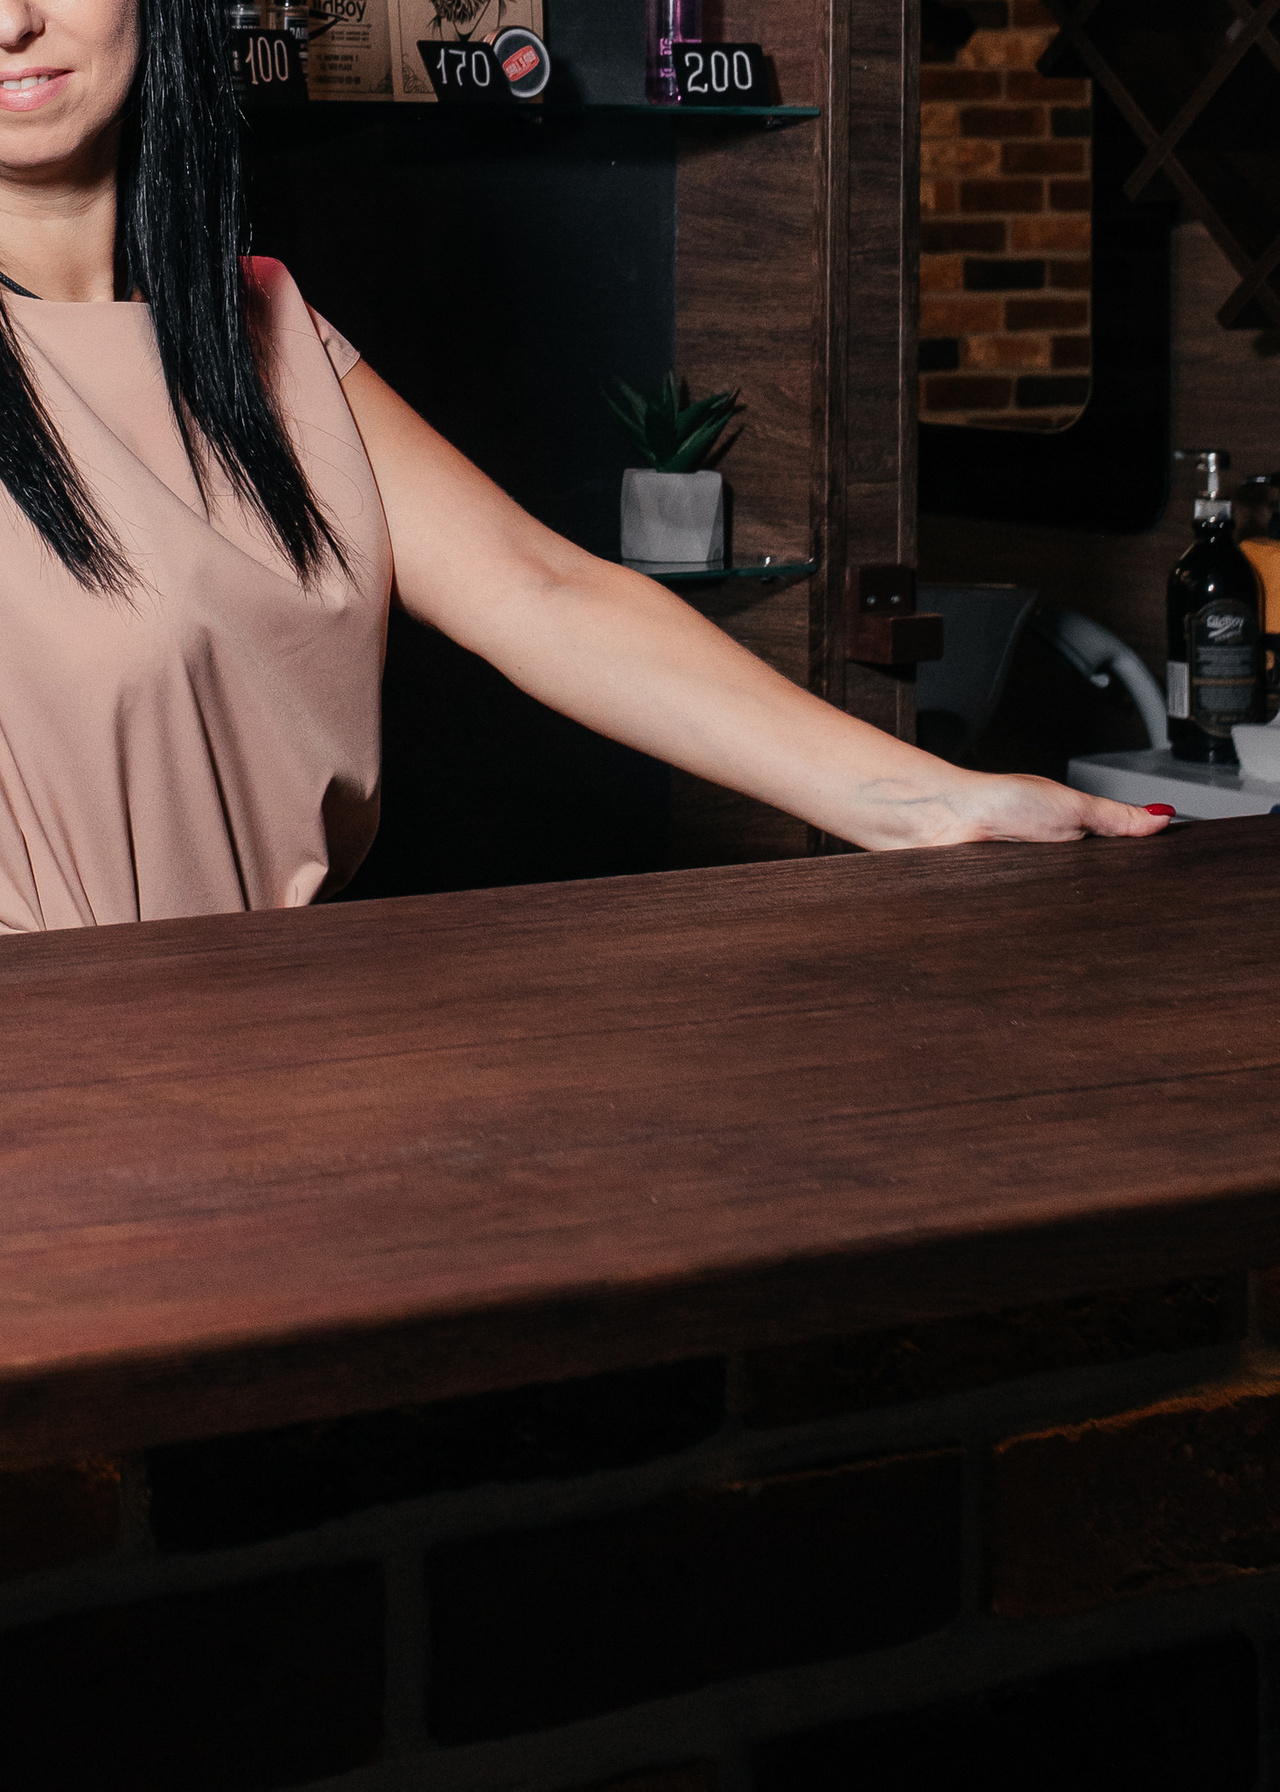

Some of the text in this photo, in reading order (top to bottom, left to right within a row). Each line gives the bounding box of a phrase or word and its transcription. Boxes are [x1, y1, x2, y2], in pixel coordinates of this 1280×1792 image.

[245, 36, 288, 85] 100
[436, 48, 490, 87] 170
[685, 51, 752, 93] 200
